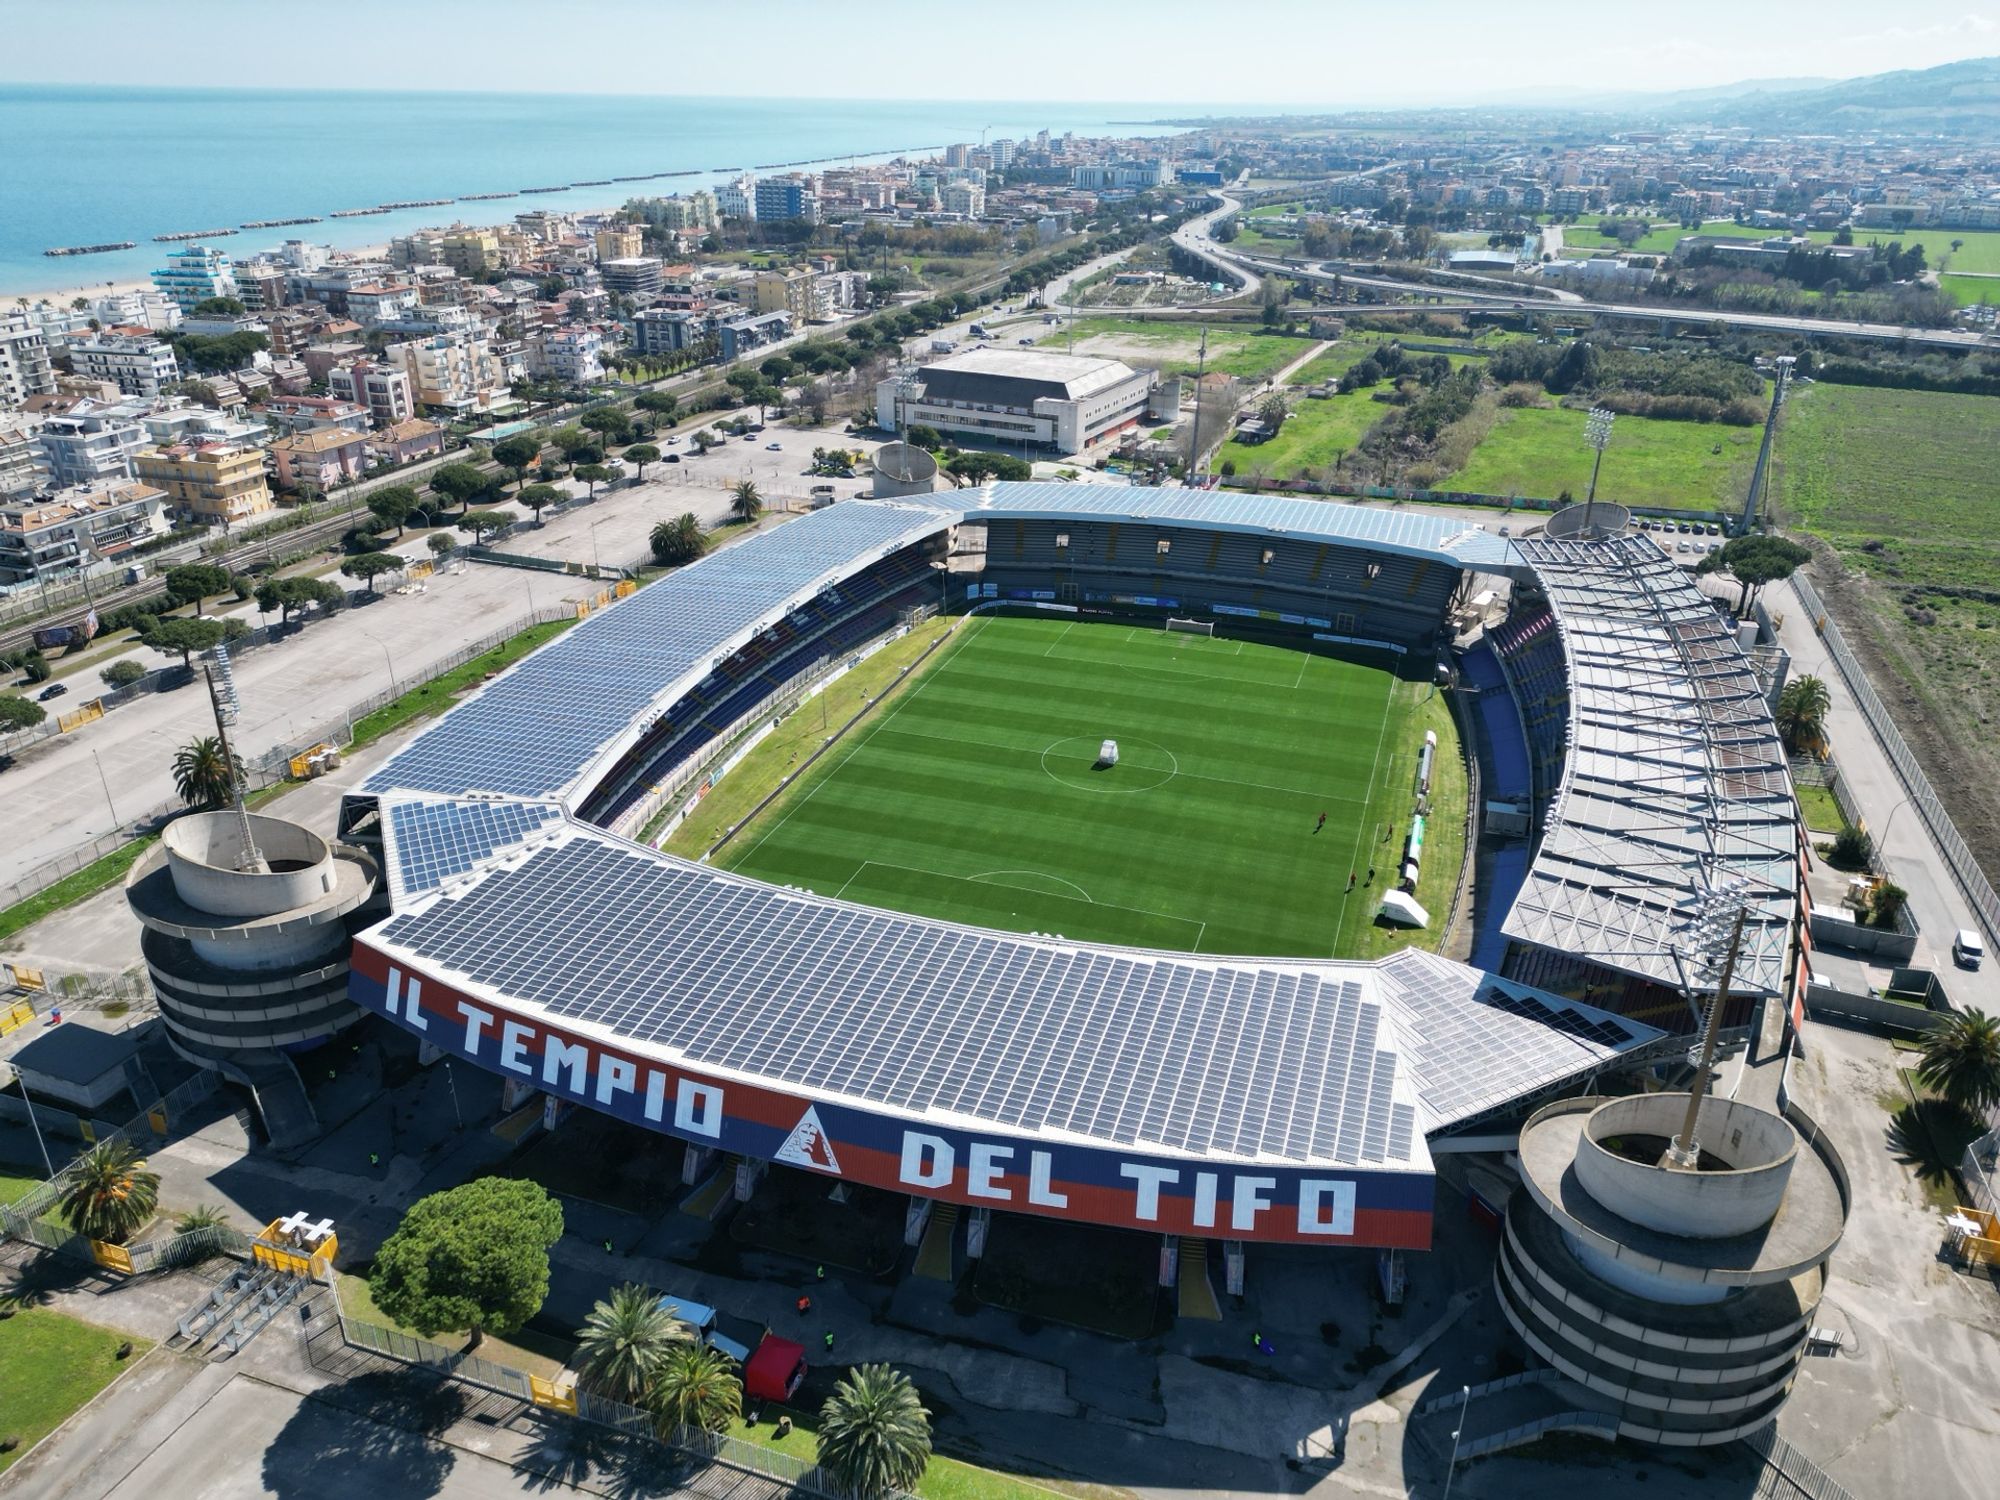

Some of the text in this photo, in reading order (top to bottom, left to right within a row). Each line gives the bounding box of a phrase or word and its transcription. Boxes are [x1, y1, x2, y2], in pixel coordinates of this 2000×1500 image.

[385, 967, 1357, 1236] IL TEMPIO DEL TIFO
